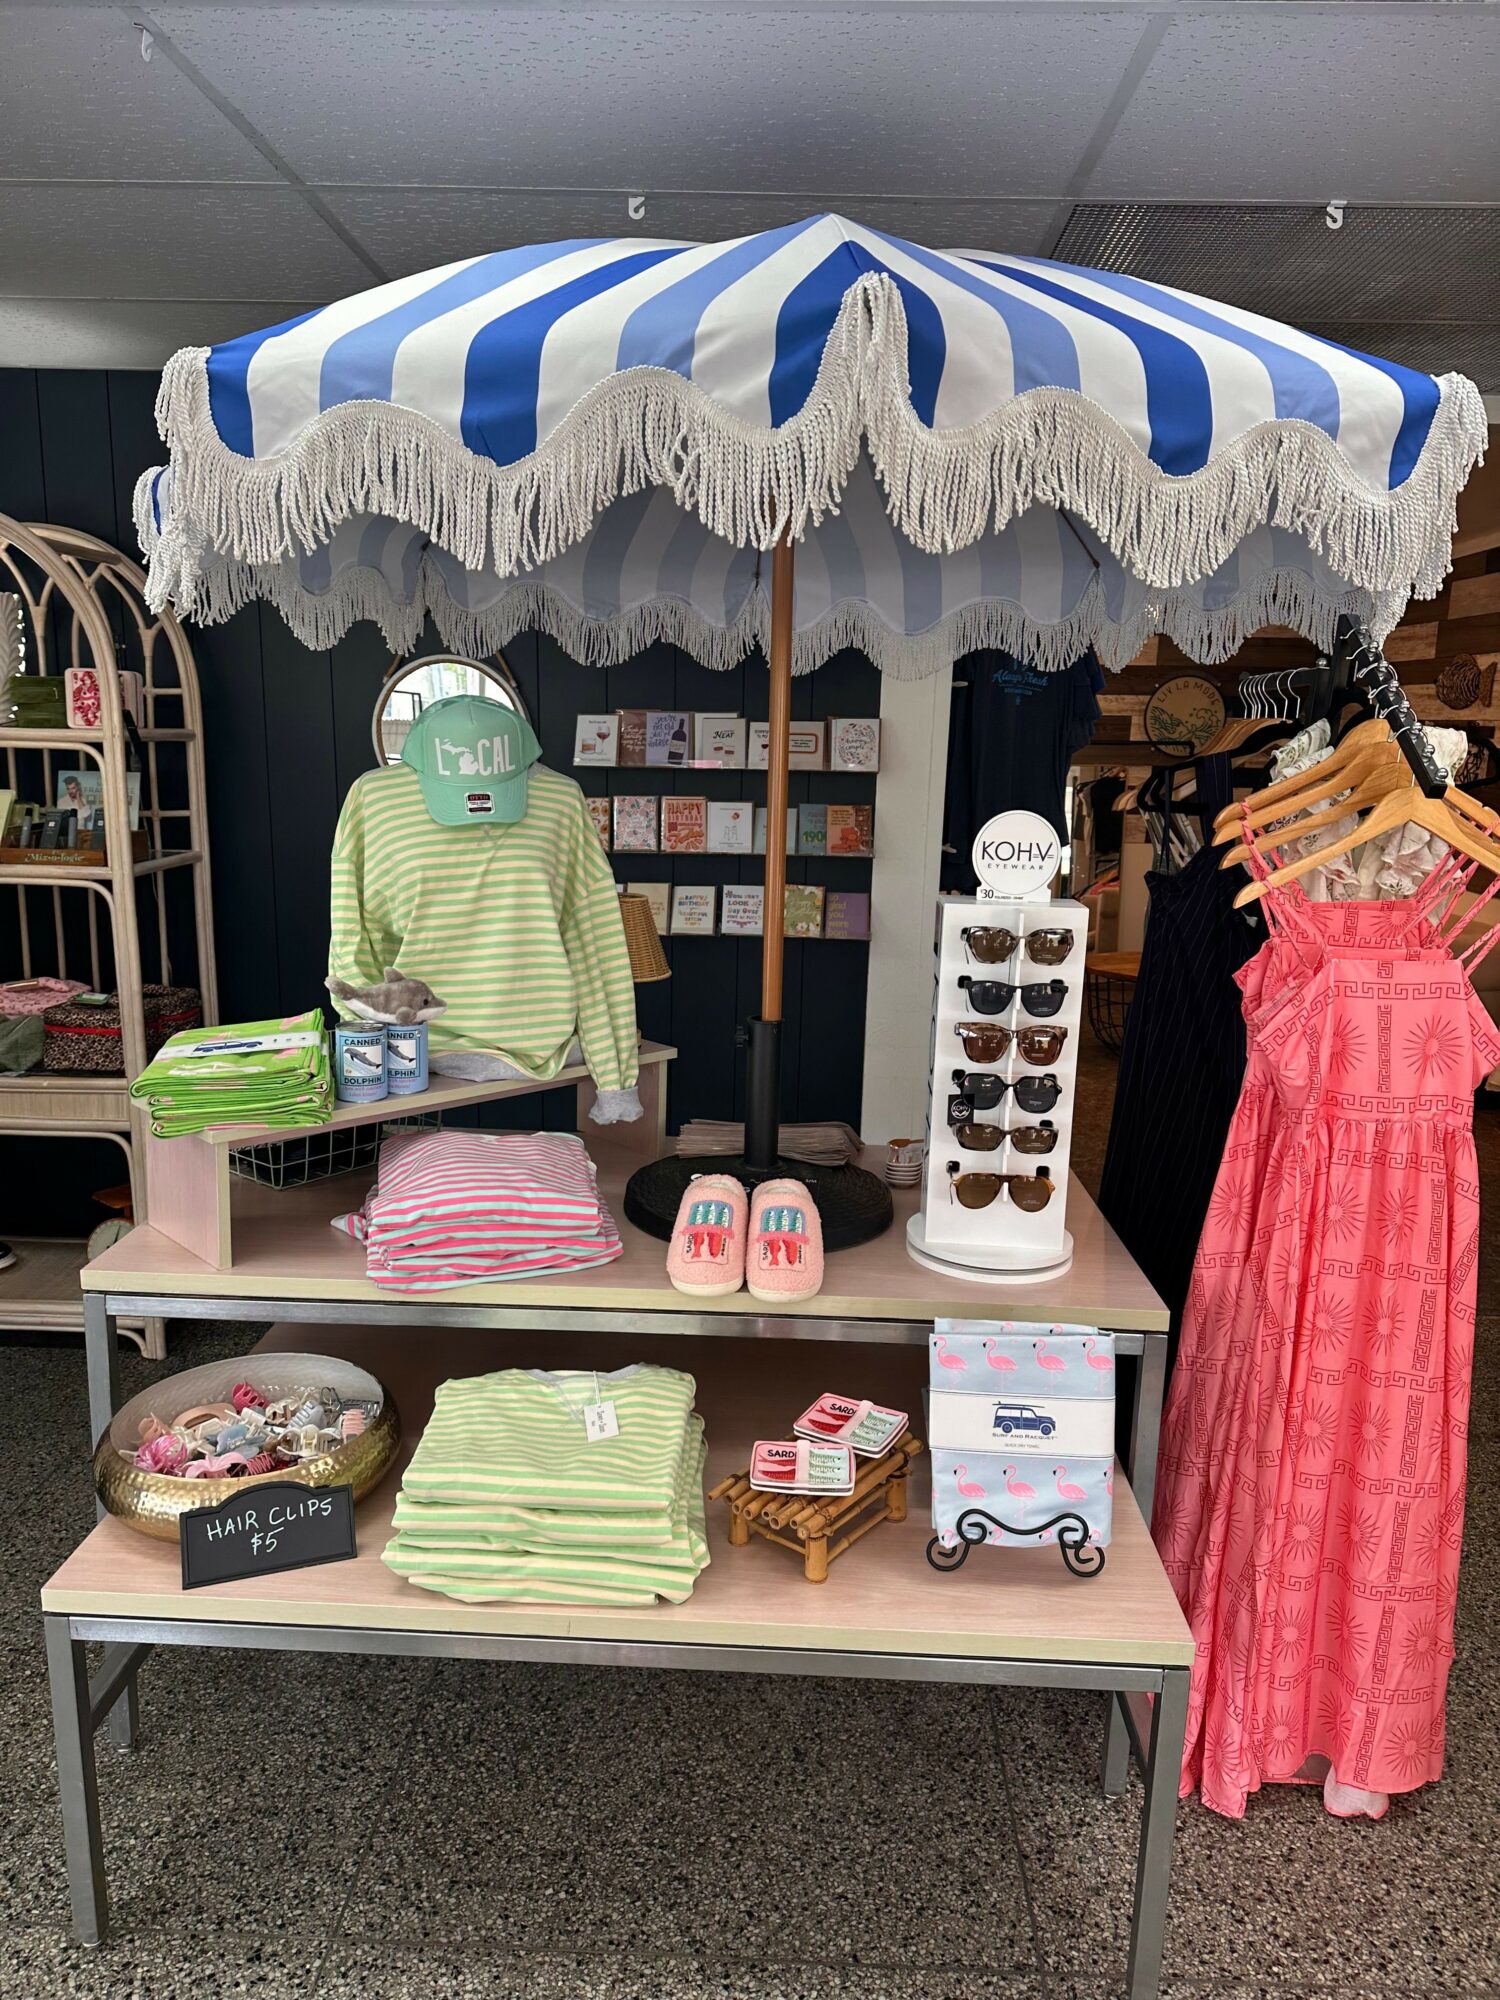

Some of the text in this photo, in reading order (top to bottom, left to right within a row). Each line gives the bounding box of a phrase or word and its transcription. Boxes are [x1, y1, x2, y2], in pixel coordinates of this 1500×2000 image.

[1157, 680, 1220, 706] LIV LA MODE
[668, 802, 703, 814] HAPPY
[981, 840, 1054, 862] KOHV
[987, 863, 1044, 871] EYEWEAR
[344, 1038, 381, 1046] CANNED
[344, 1076, 382, 1085] DOLPHIN
[206, 1497, 332, 1542] HAIR CLIPS
[250, 1526, 285, 1556] $5
